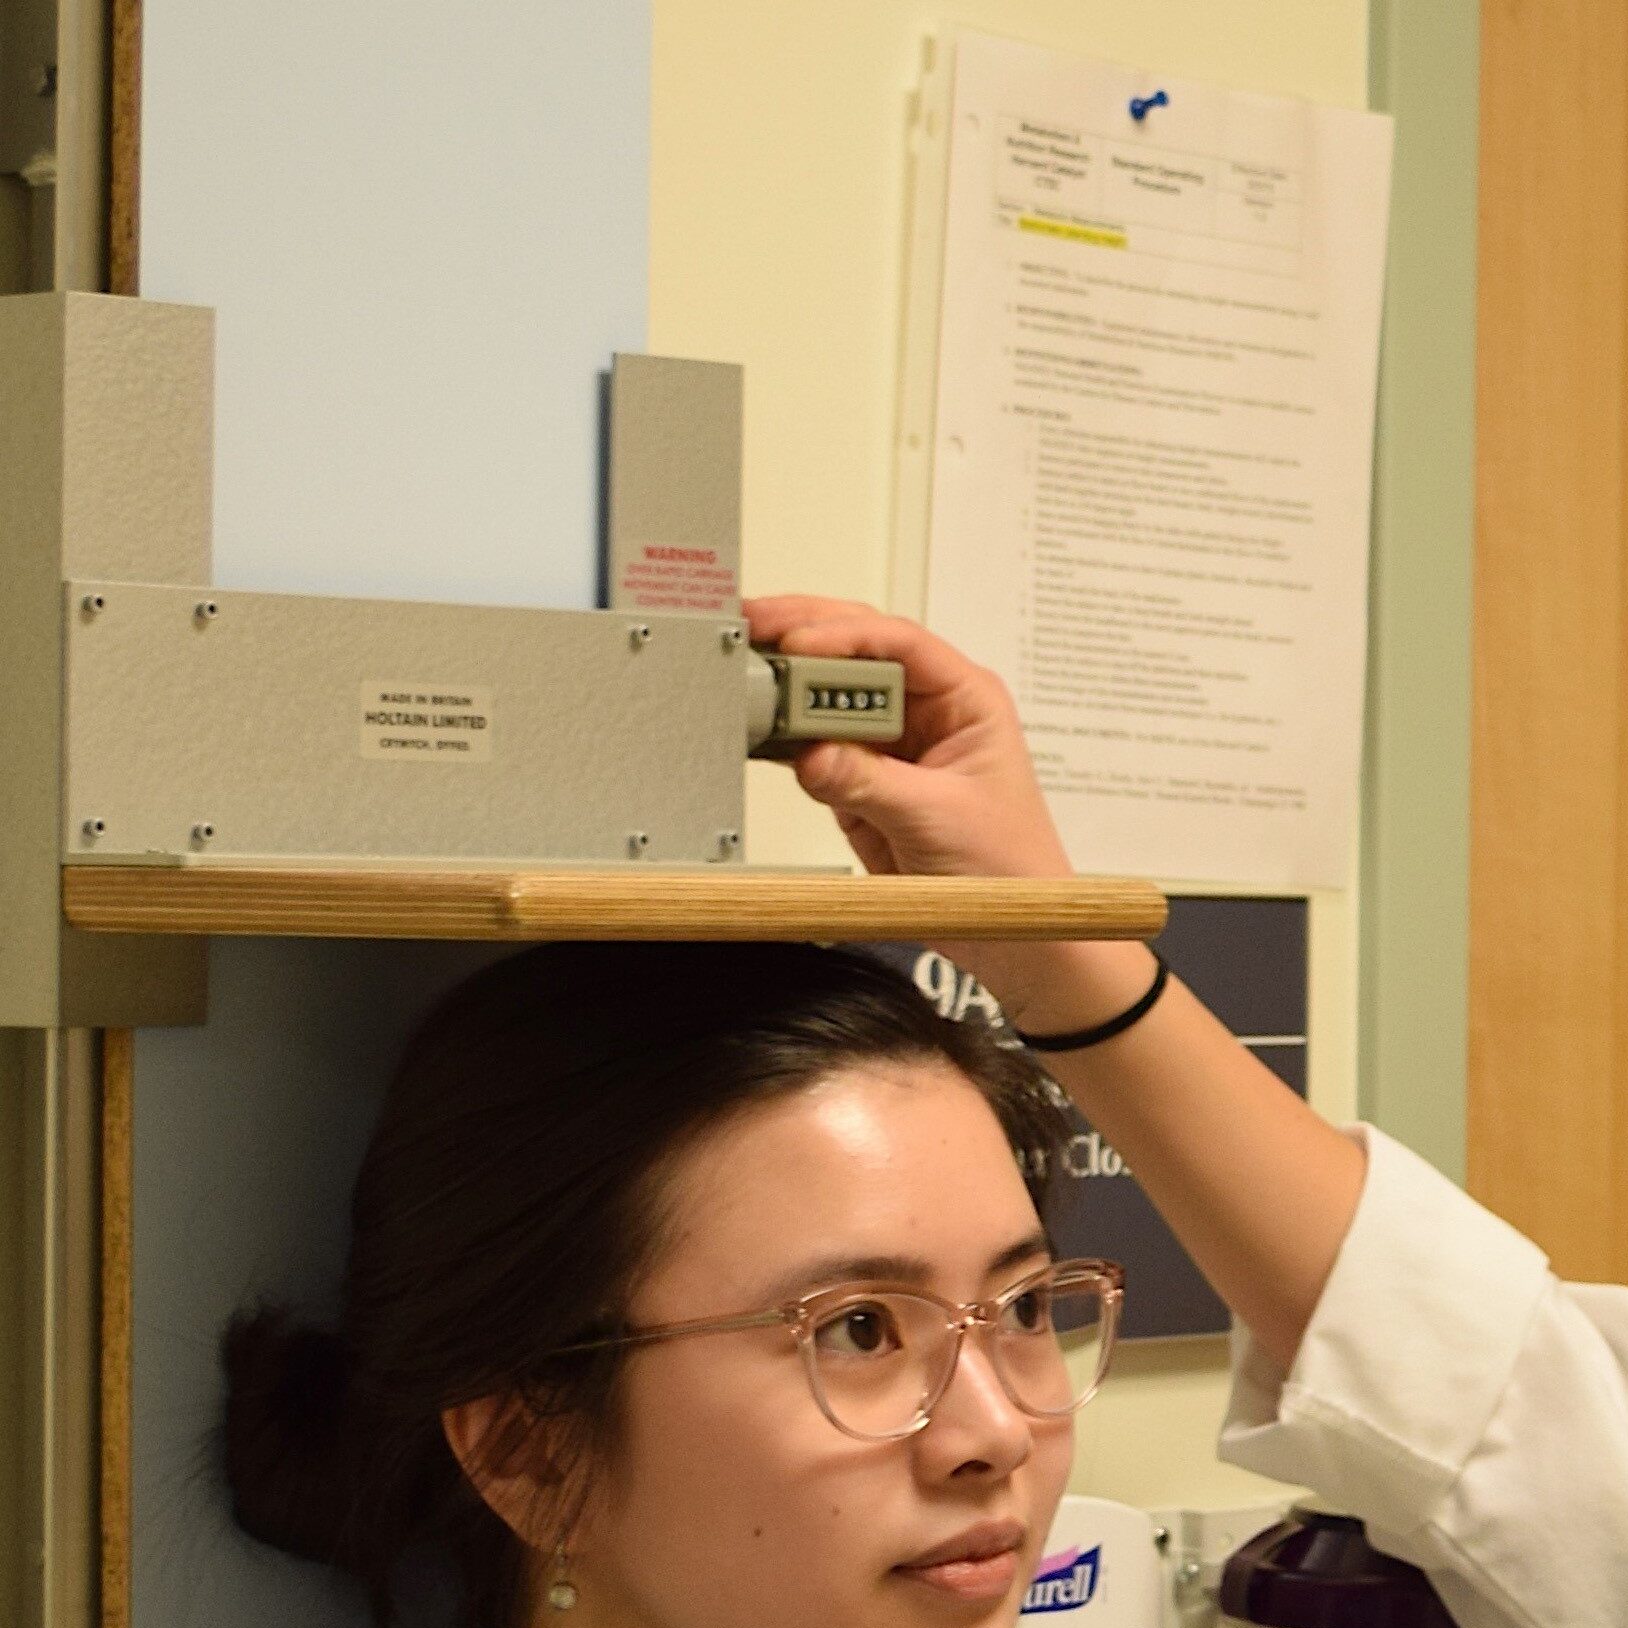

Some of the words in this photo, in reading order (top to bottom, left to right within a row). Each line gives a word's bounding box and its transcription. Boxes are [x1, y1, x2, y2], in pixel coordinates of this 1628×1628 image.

[643, 546, 717, 564] WARNING
[380, 692, 412, 704] MADE
[415, 694, 428, 704] IN
[431, 695, 472, 706] BRITAIN
[364, 711, 428, 727] HOLTAIN
[431, 714, 487, 729] LIMITED
[1020, 1563, 1093, 1610] urell
